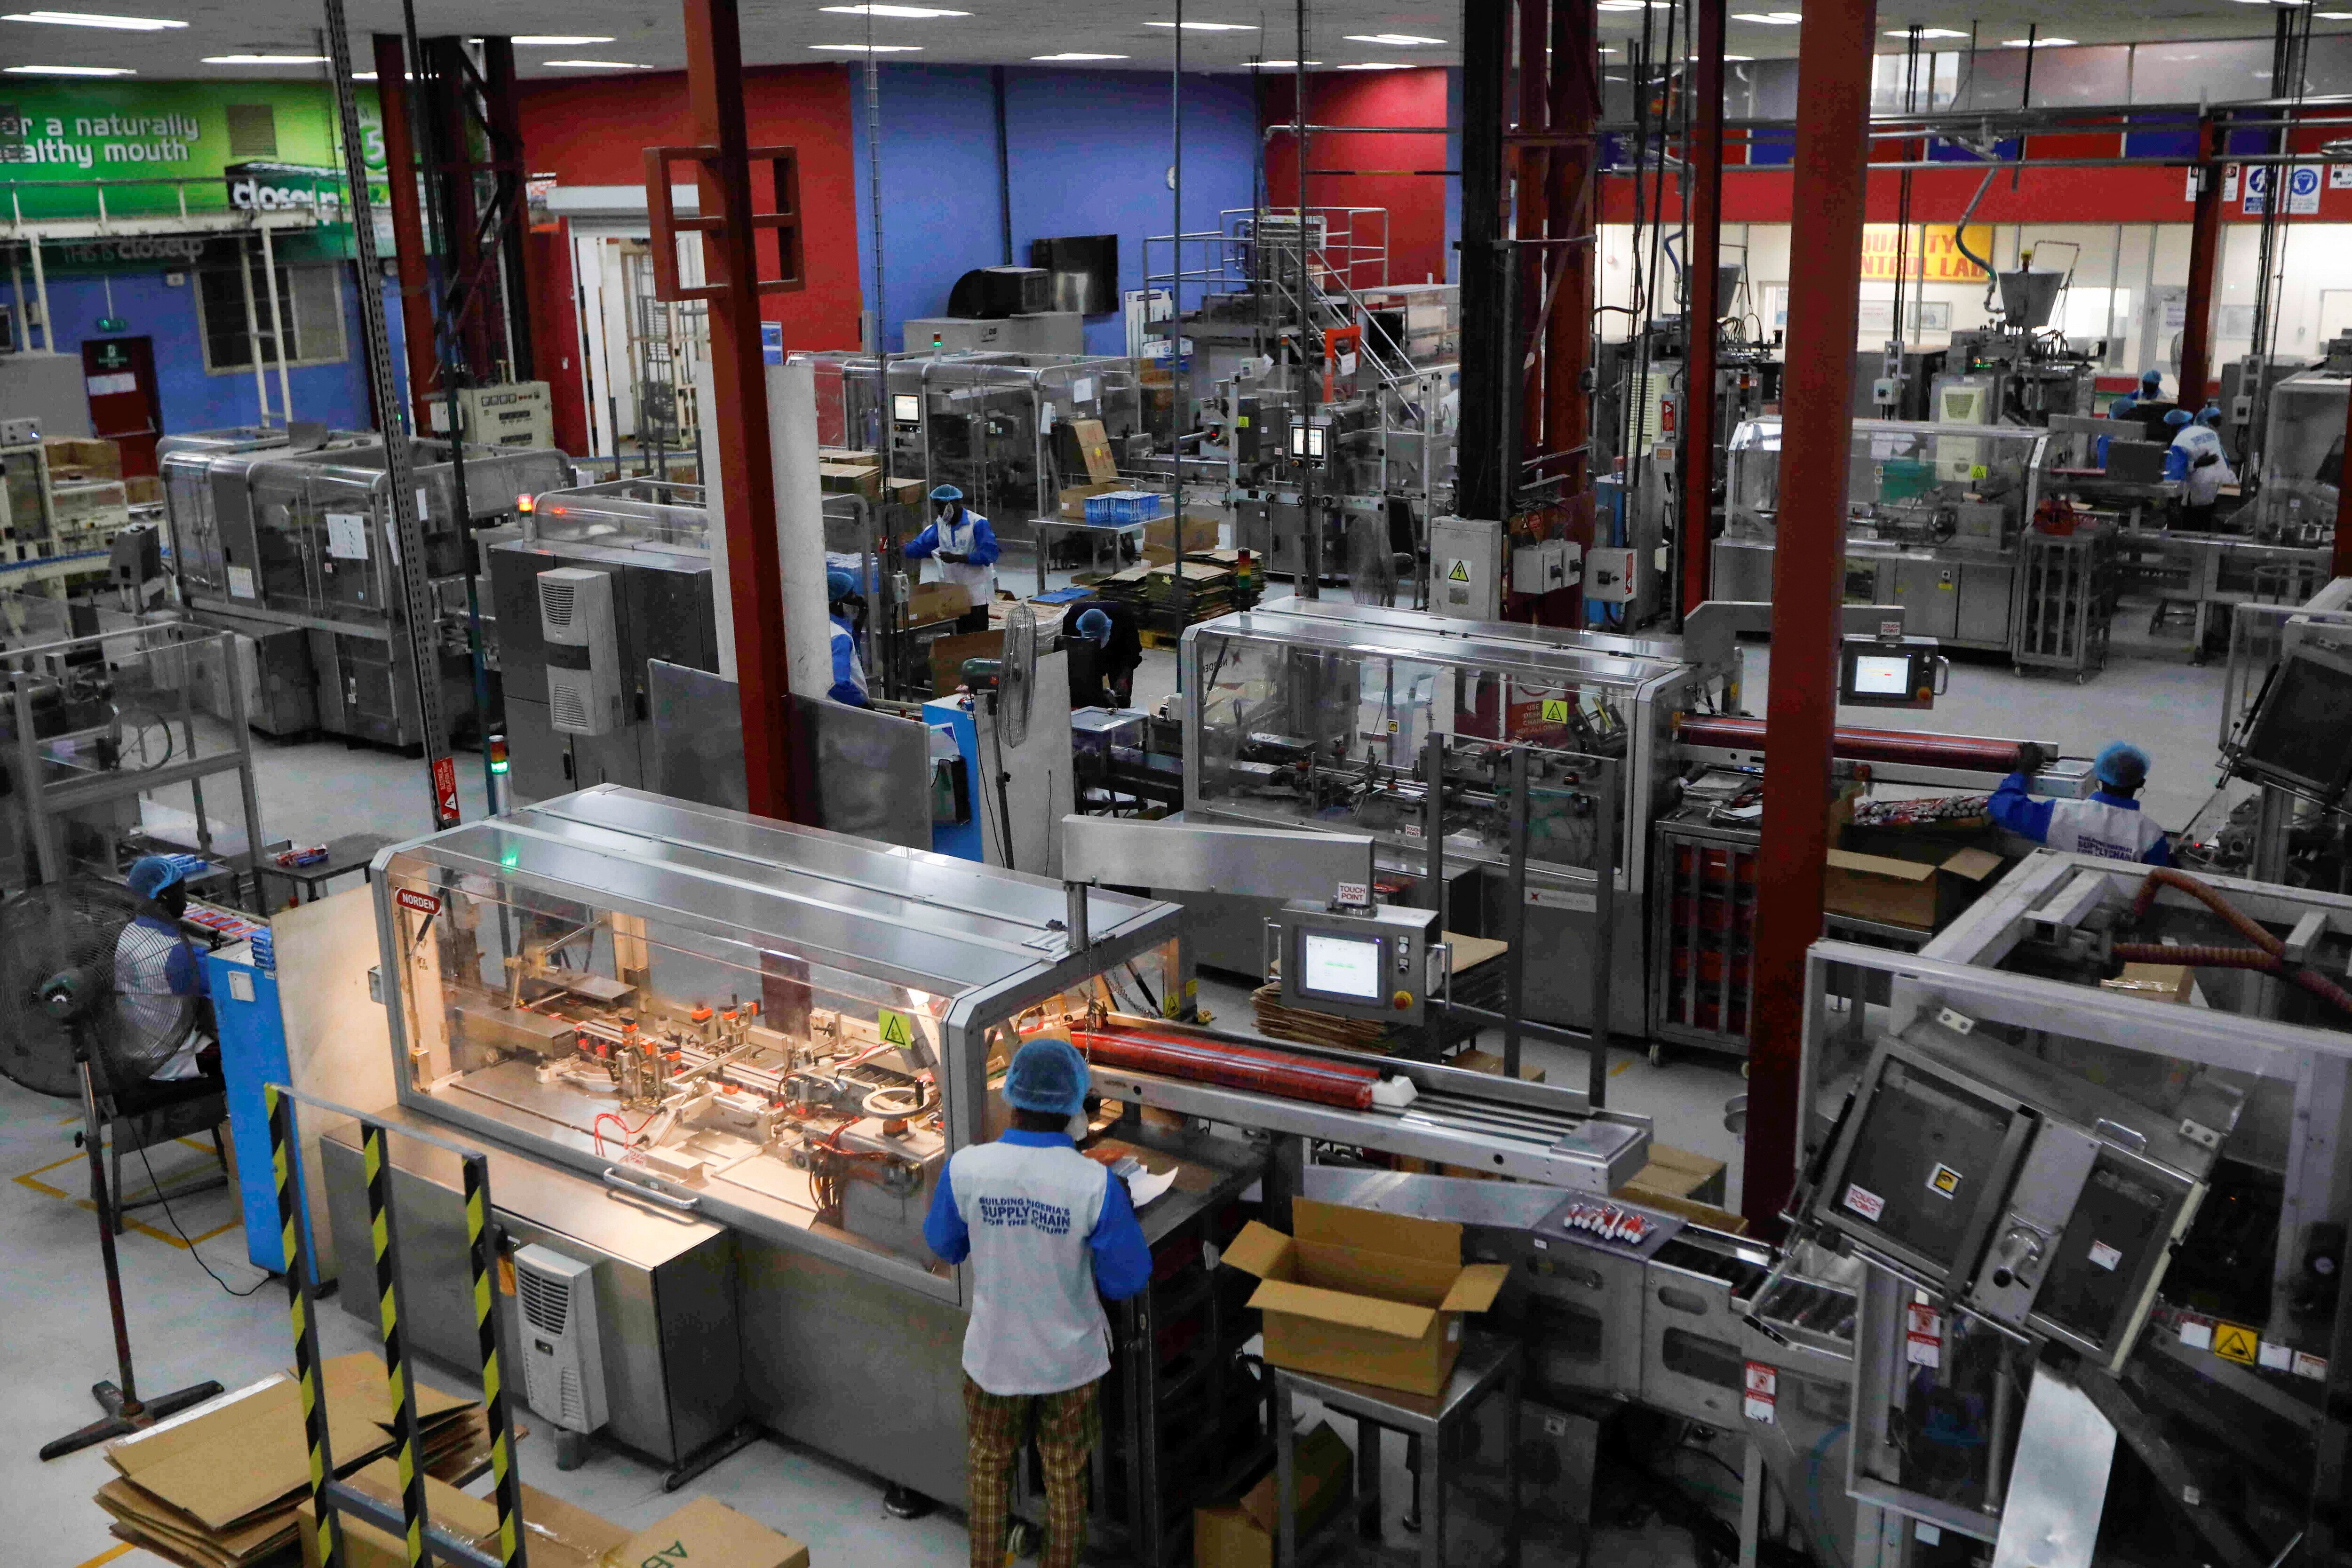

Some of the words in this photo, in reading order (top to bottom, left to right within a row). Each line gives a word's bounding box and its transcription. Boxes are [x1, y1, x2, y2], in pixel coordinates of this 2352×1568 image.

[47, 118, 64, 136] a
[75, 113, 199, 141] naturally
[0, 138, 93, 168] ealthy
[104, 139, 188, 162] mouth
[1863, 234, 1957, 254] QUALTY
[1861, 256, 1931, 276] NTROL
[402, 893, 435, 911] NORDEN
[979, 1196, 1024, 1206] BUILDING
[1026, 1199, 1071, 1217] NIGERIA'S
[1850, 1197, 1877, 1213] POINT
[1851, 1188, 1881, 1209] TOUCH
[981, 1205, 1030, 1218] SUPPLY
[1032, 1210, 1071, 1227] CHAIN
[983, 1217, 1004, 1226] FOR
[1008, 1218, 1027, 1227] THE
[1031, 1218, 1069, 1235] FUTURE
